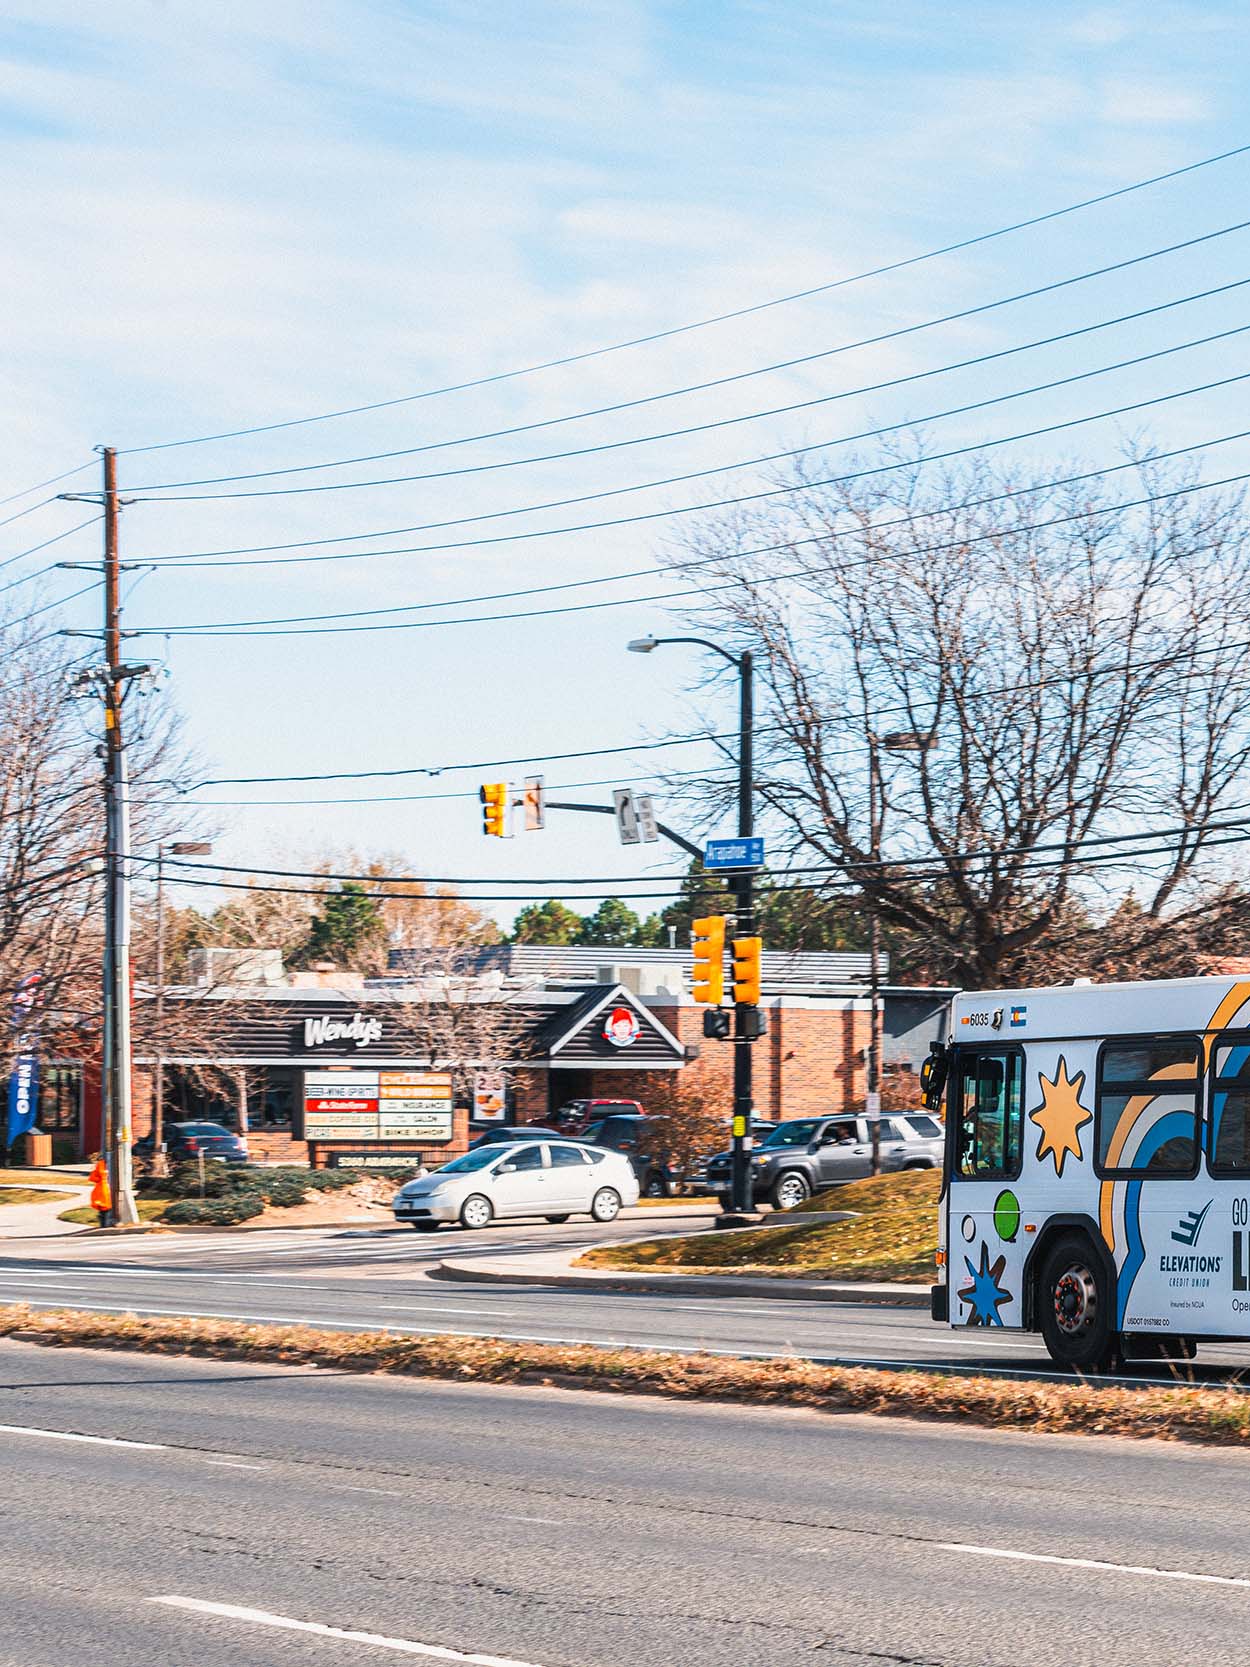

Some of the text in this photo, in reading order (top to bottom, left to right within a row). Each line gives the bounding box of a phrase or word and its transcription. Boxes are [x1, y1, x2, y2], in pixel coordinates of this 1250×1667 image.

[970, 1013, 989, 1026] 6035
[304, 1013, 383, 1047] Wendy's
[16, 1064, 32, 1115] OPEN
[1232, 1198, 1248, 1226] GO
[1160, 1255, 1221, 1272] ELEVATIONS
[1169, 1277, 1210, 1288] CREDIT UNION
[1127, 1317, 1143, 1325] USDOT
